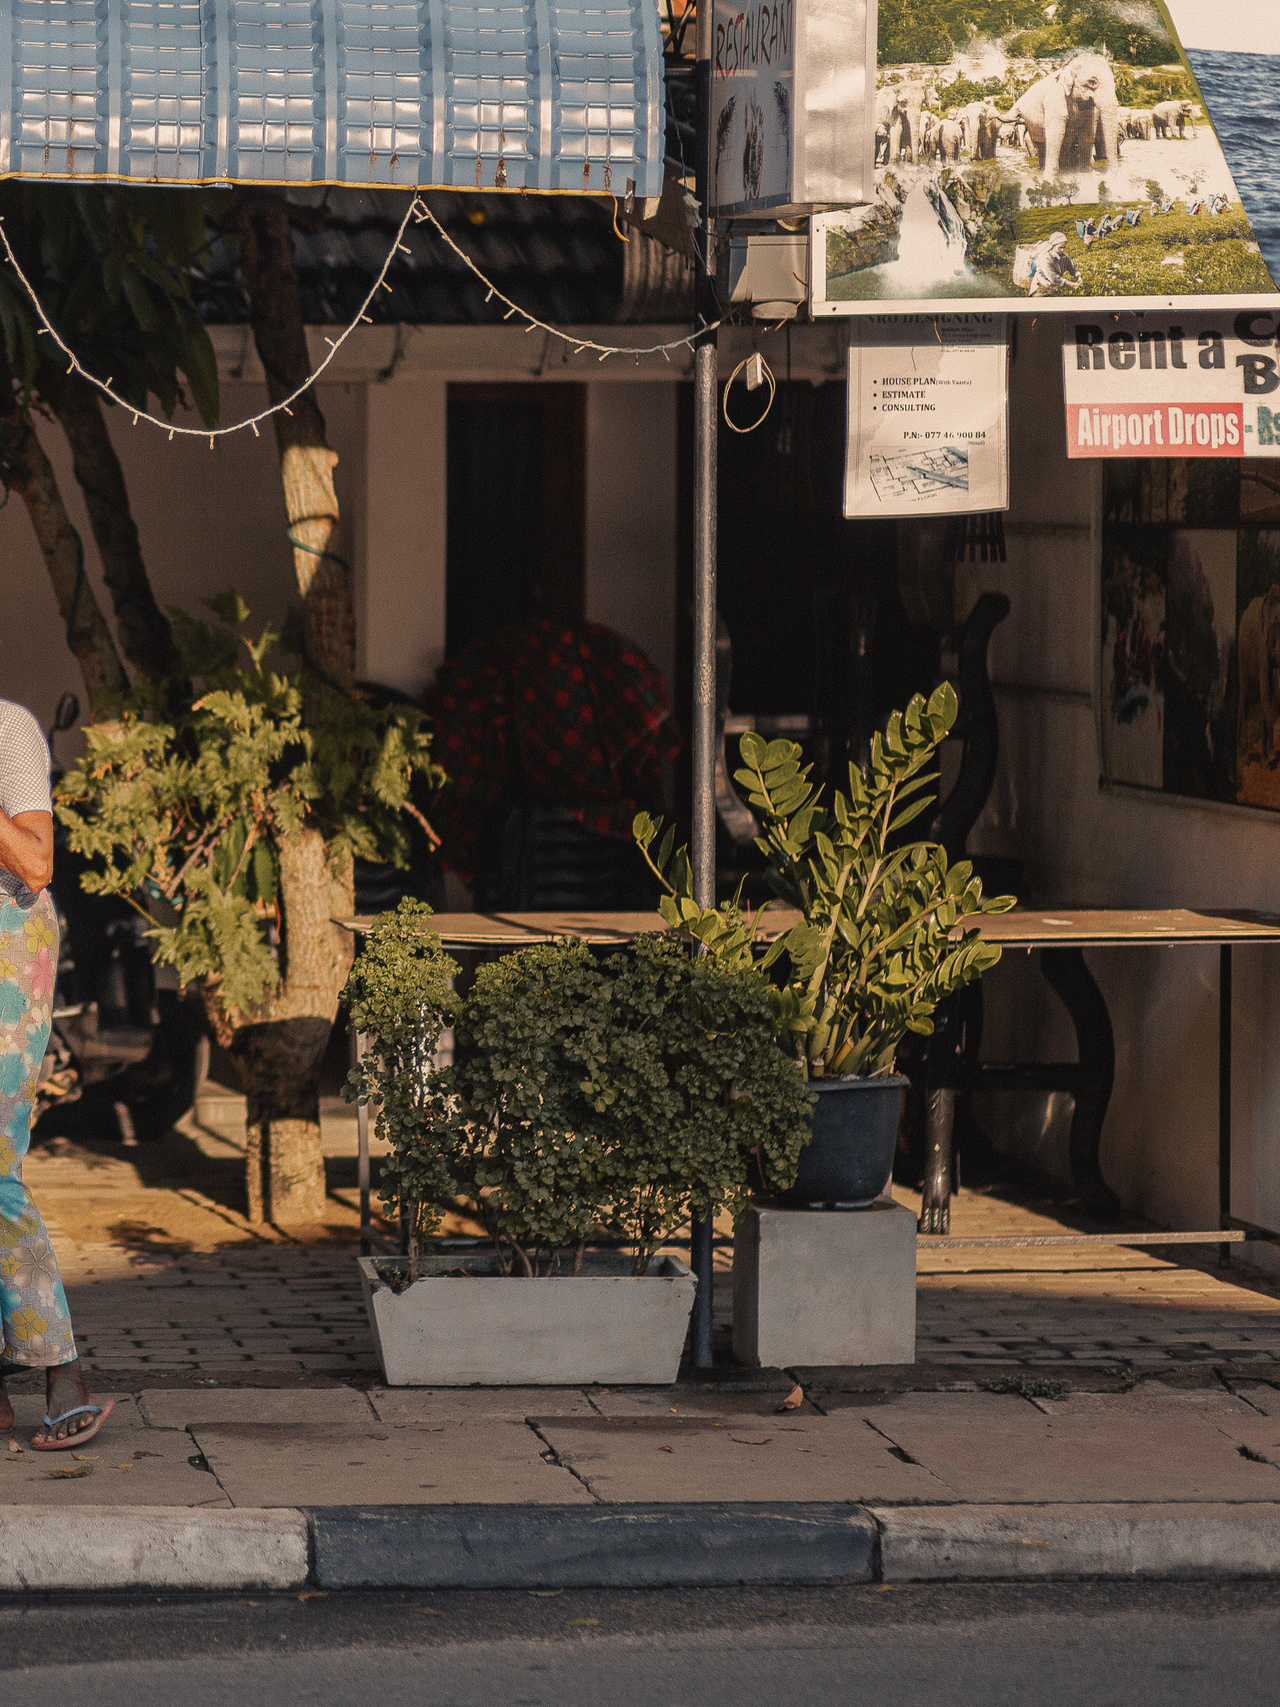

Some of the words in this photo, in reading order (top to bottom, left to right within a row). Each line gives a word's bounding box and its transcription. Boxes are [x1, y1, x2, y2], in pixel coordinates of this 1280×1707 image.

[1075, 324, 1187, 370] Rent
[1198, 330, 1226, 369] a
[882, 377, 911, 386] HOUSE
[882, 390, 926, 399] ESTIMATE
[882, 403, 936, 412] CONSULTING
[1077, 408, 1164, 449] Airport
[1168, 407, 1240, 449] Drops
[925, 431, 941, 439] 077
[975, 431, 986, 439] 84
